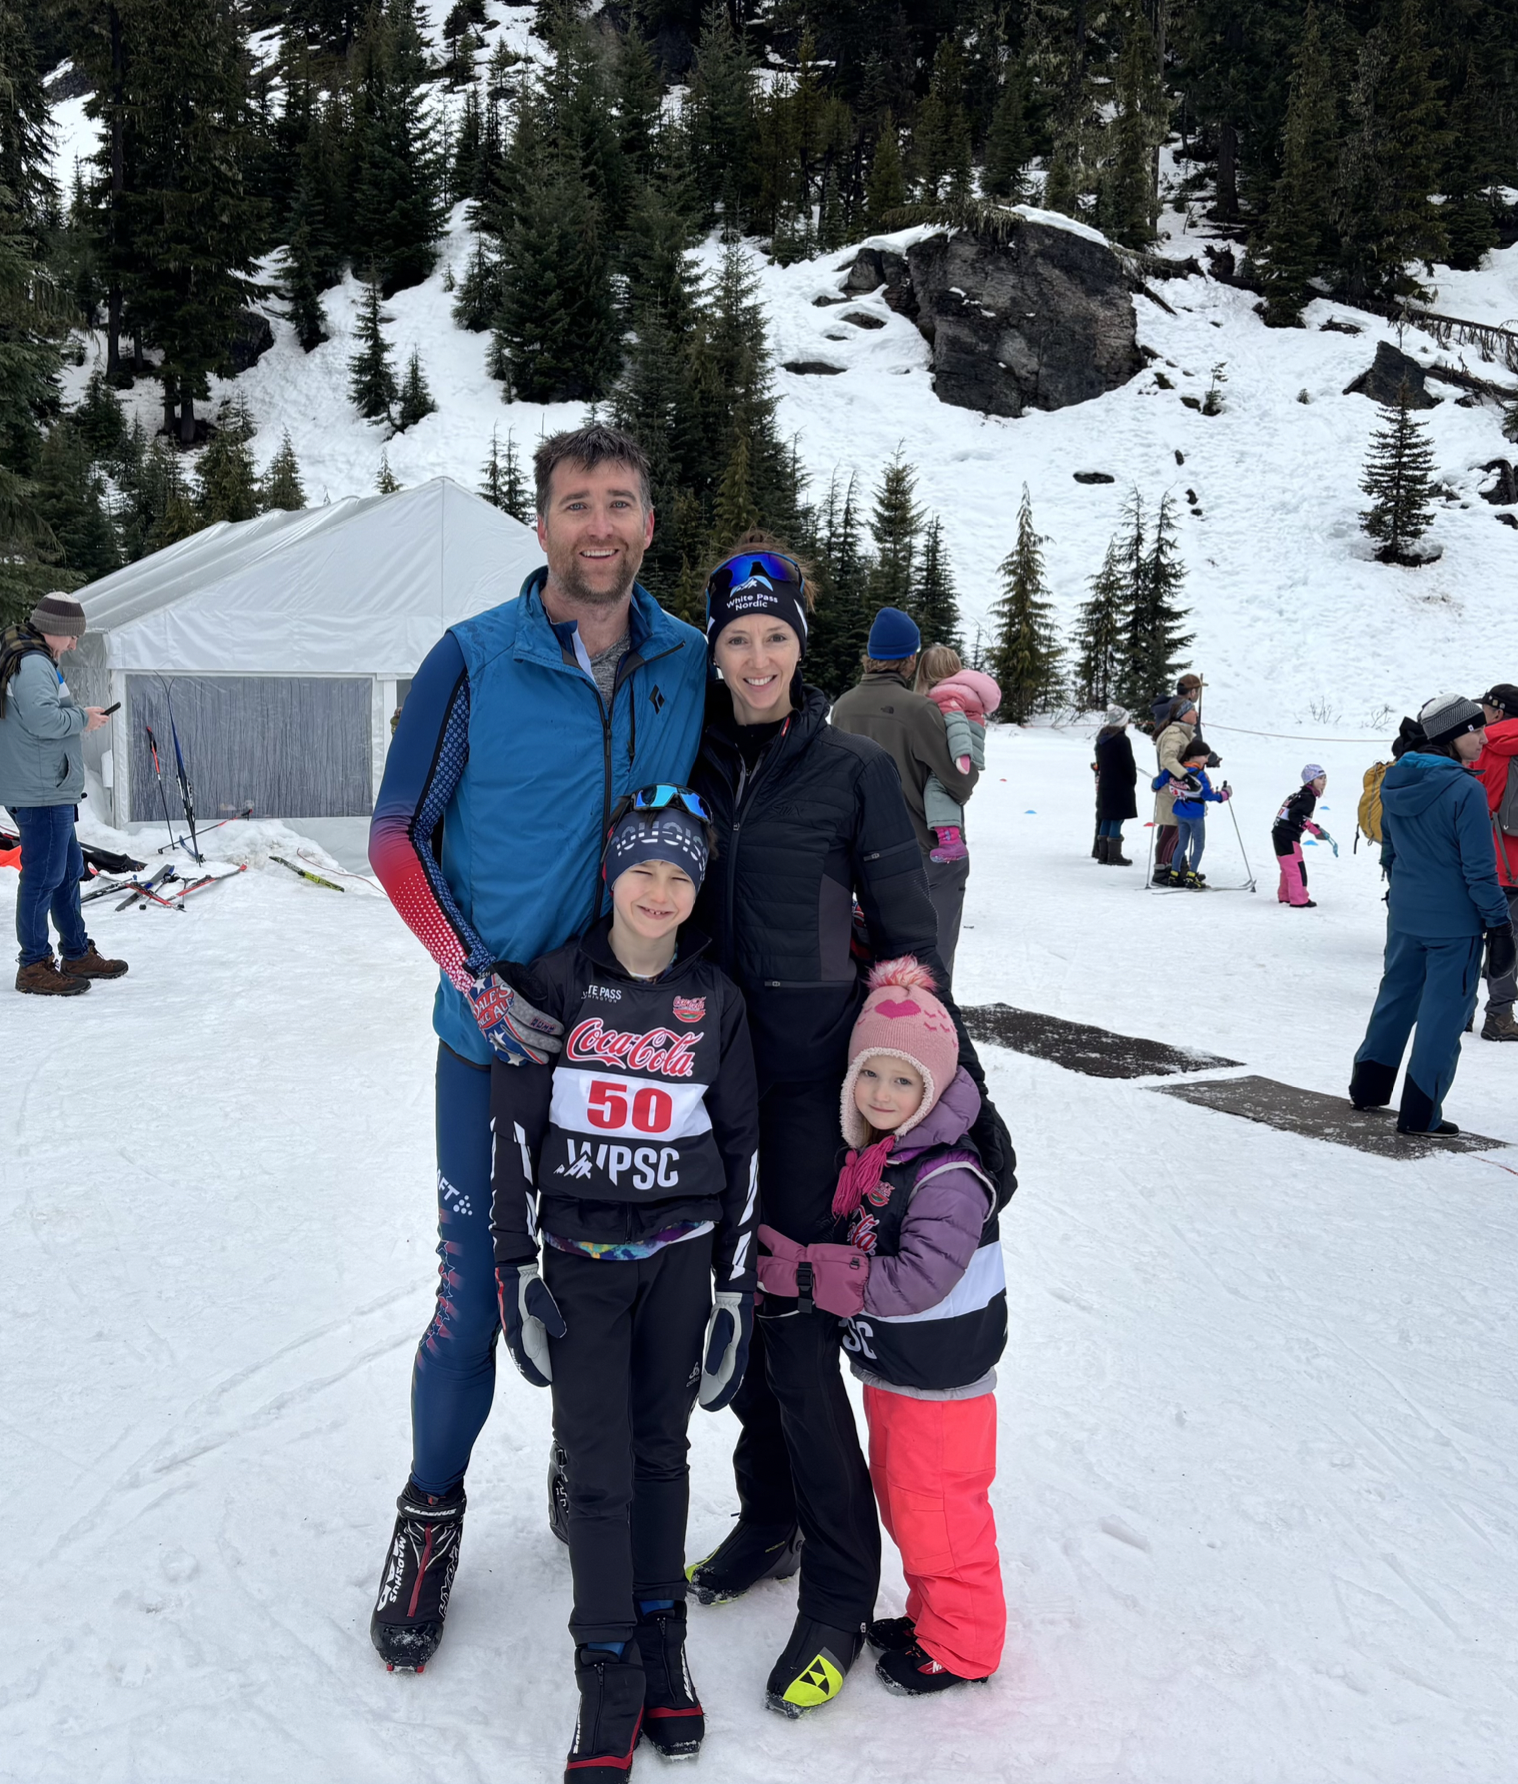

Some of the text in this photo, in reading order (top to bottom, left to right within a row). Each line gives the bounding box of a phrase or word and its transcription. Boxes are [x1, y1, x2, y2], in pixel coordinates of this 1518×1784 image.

[726, 593, 778, 609] White Pass
[735, 600, 768, 611] Nordic
[600, 987, 622, 1000] PASS
[566, 1017, 705, 1077] Coca-Cola
[587, 1080, 673, 1133] 50
[841, 1317, 878, 1360] SC
[389, 1536, 407, 1603] MADSHUS
